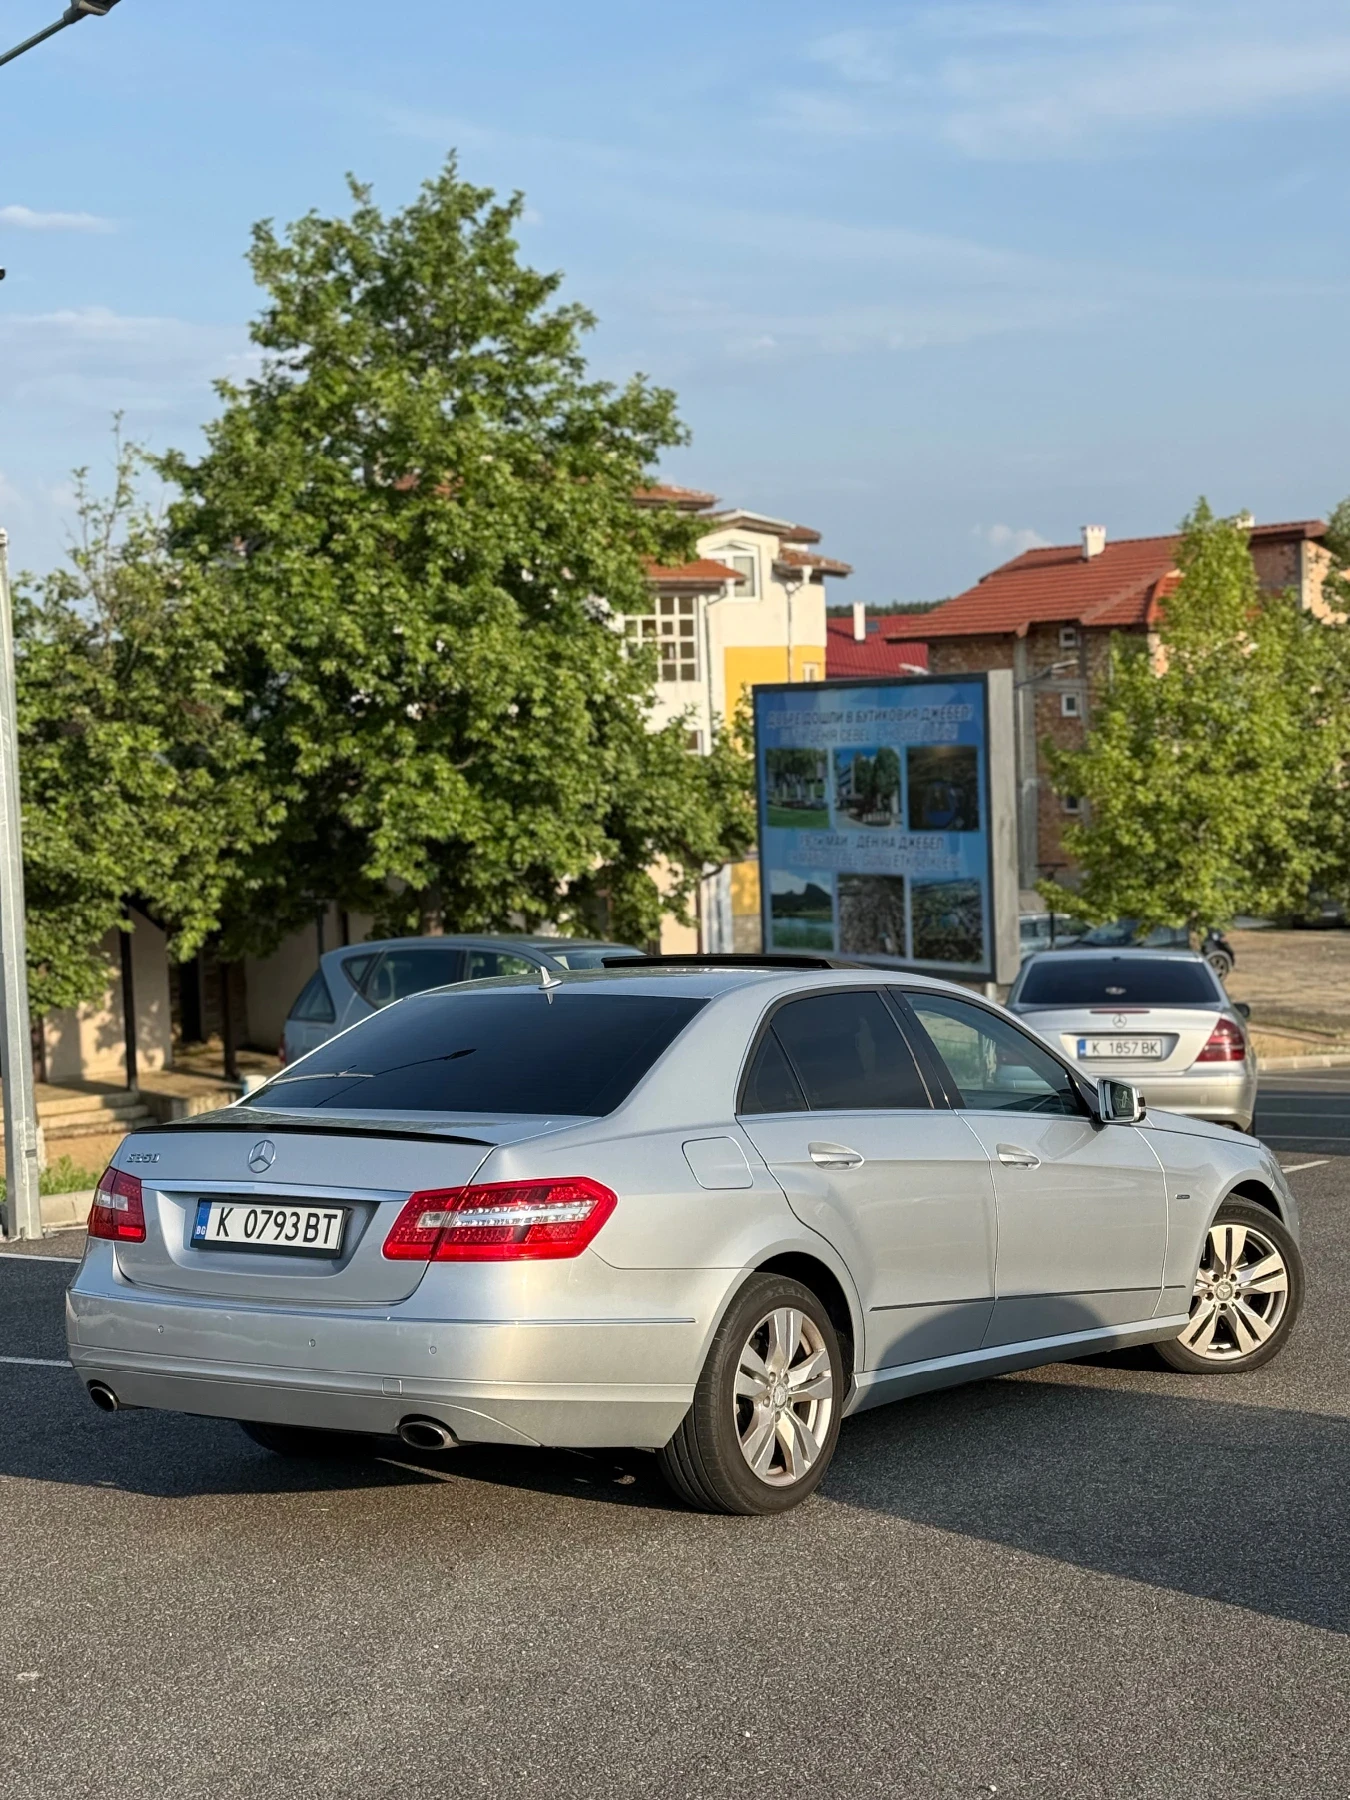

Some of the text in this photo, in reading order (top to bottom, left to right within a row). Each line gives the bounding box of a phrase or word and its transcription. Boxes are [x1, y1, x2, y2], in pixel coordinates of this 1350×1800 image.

[1092, 1042, 1100, 1054] K
[216, 1207, 234, 1237] K
[196, 1226, 206, 1235] BG
